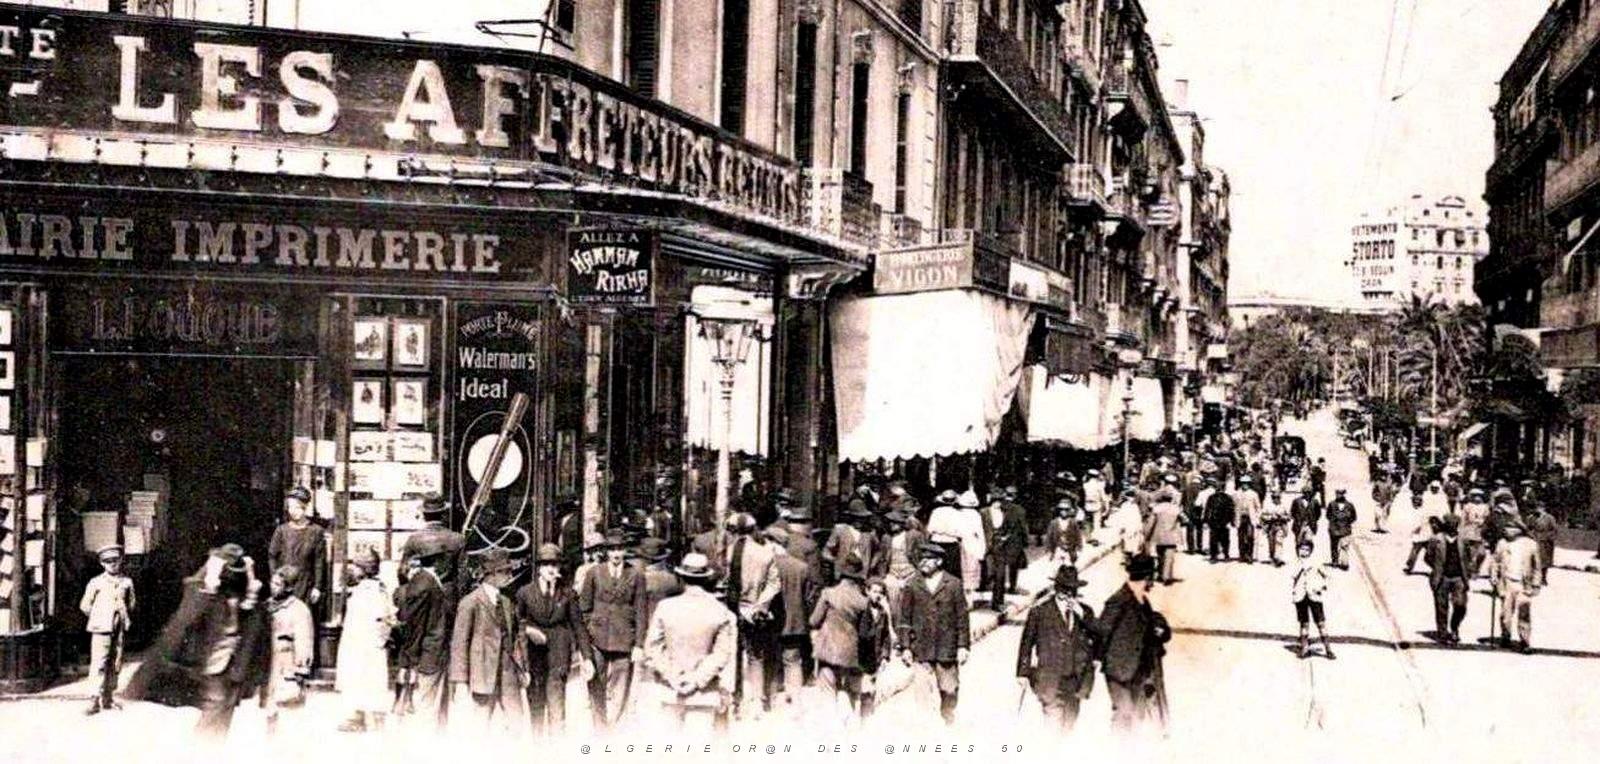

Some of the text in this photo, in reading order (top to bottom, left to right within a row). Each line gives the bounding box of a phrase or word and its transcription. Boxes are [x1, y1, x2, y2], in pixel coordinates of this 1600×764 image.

[112, 35, 340, 134] LES
[171, 219, 500, 273] IMPRIMERIE
[580, 232, 625, 243] ALLEZ
[570, 246, 640, 275] HAMMAM
[888, 264, 959, 287] VIGON
